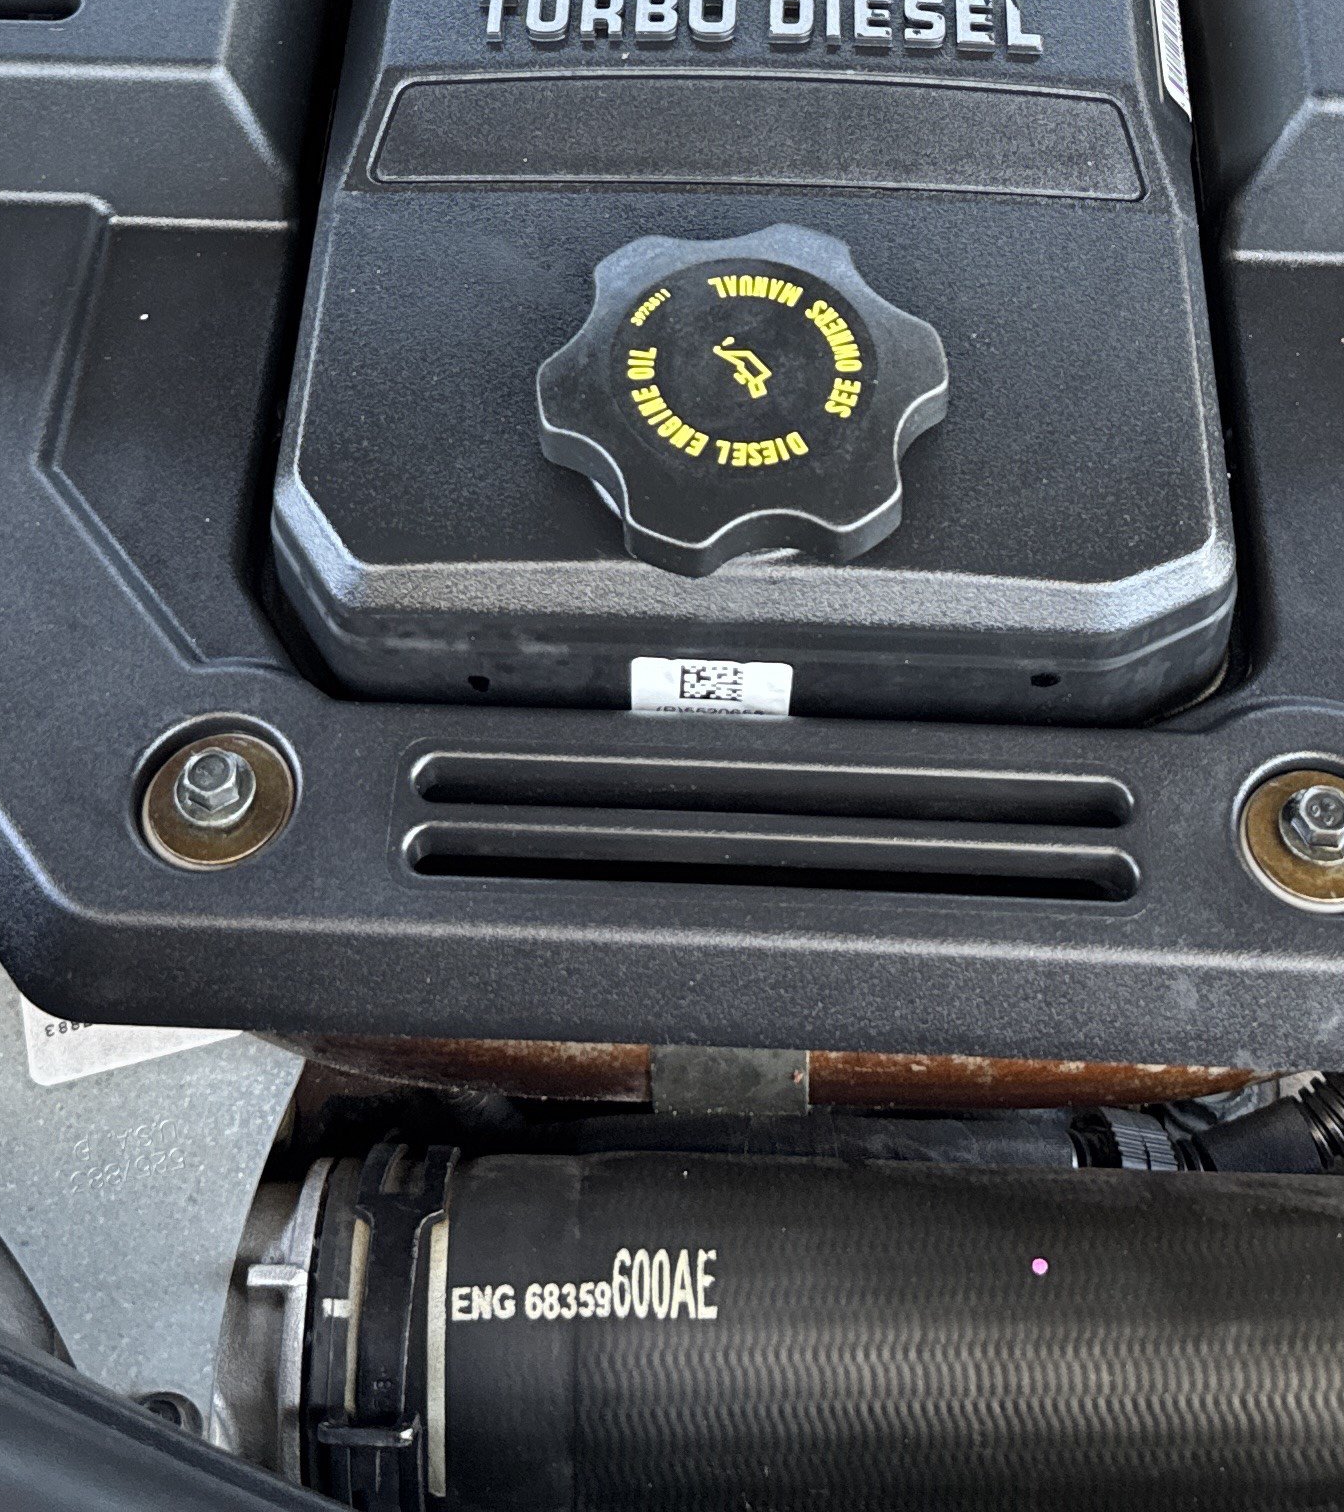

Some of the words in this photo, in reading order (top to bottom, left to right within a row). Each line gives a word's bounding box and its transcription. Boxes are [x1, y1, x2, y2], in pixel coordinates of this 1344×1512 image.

[707, 274, 804, 307] MANUAL
[805, 299, 863, 373] OWNERS
[627, 346, 657, 380] OIL
[825, 378, 862, 418] SEE
[631, 383, 710, 457] ENGINE
[715, 430, 809, 467] DIESEL
[451, 1284, 516, 1321] ENG
[524, 1247, 719, 1320] 68359600AE
